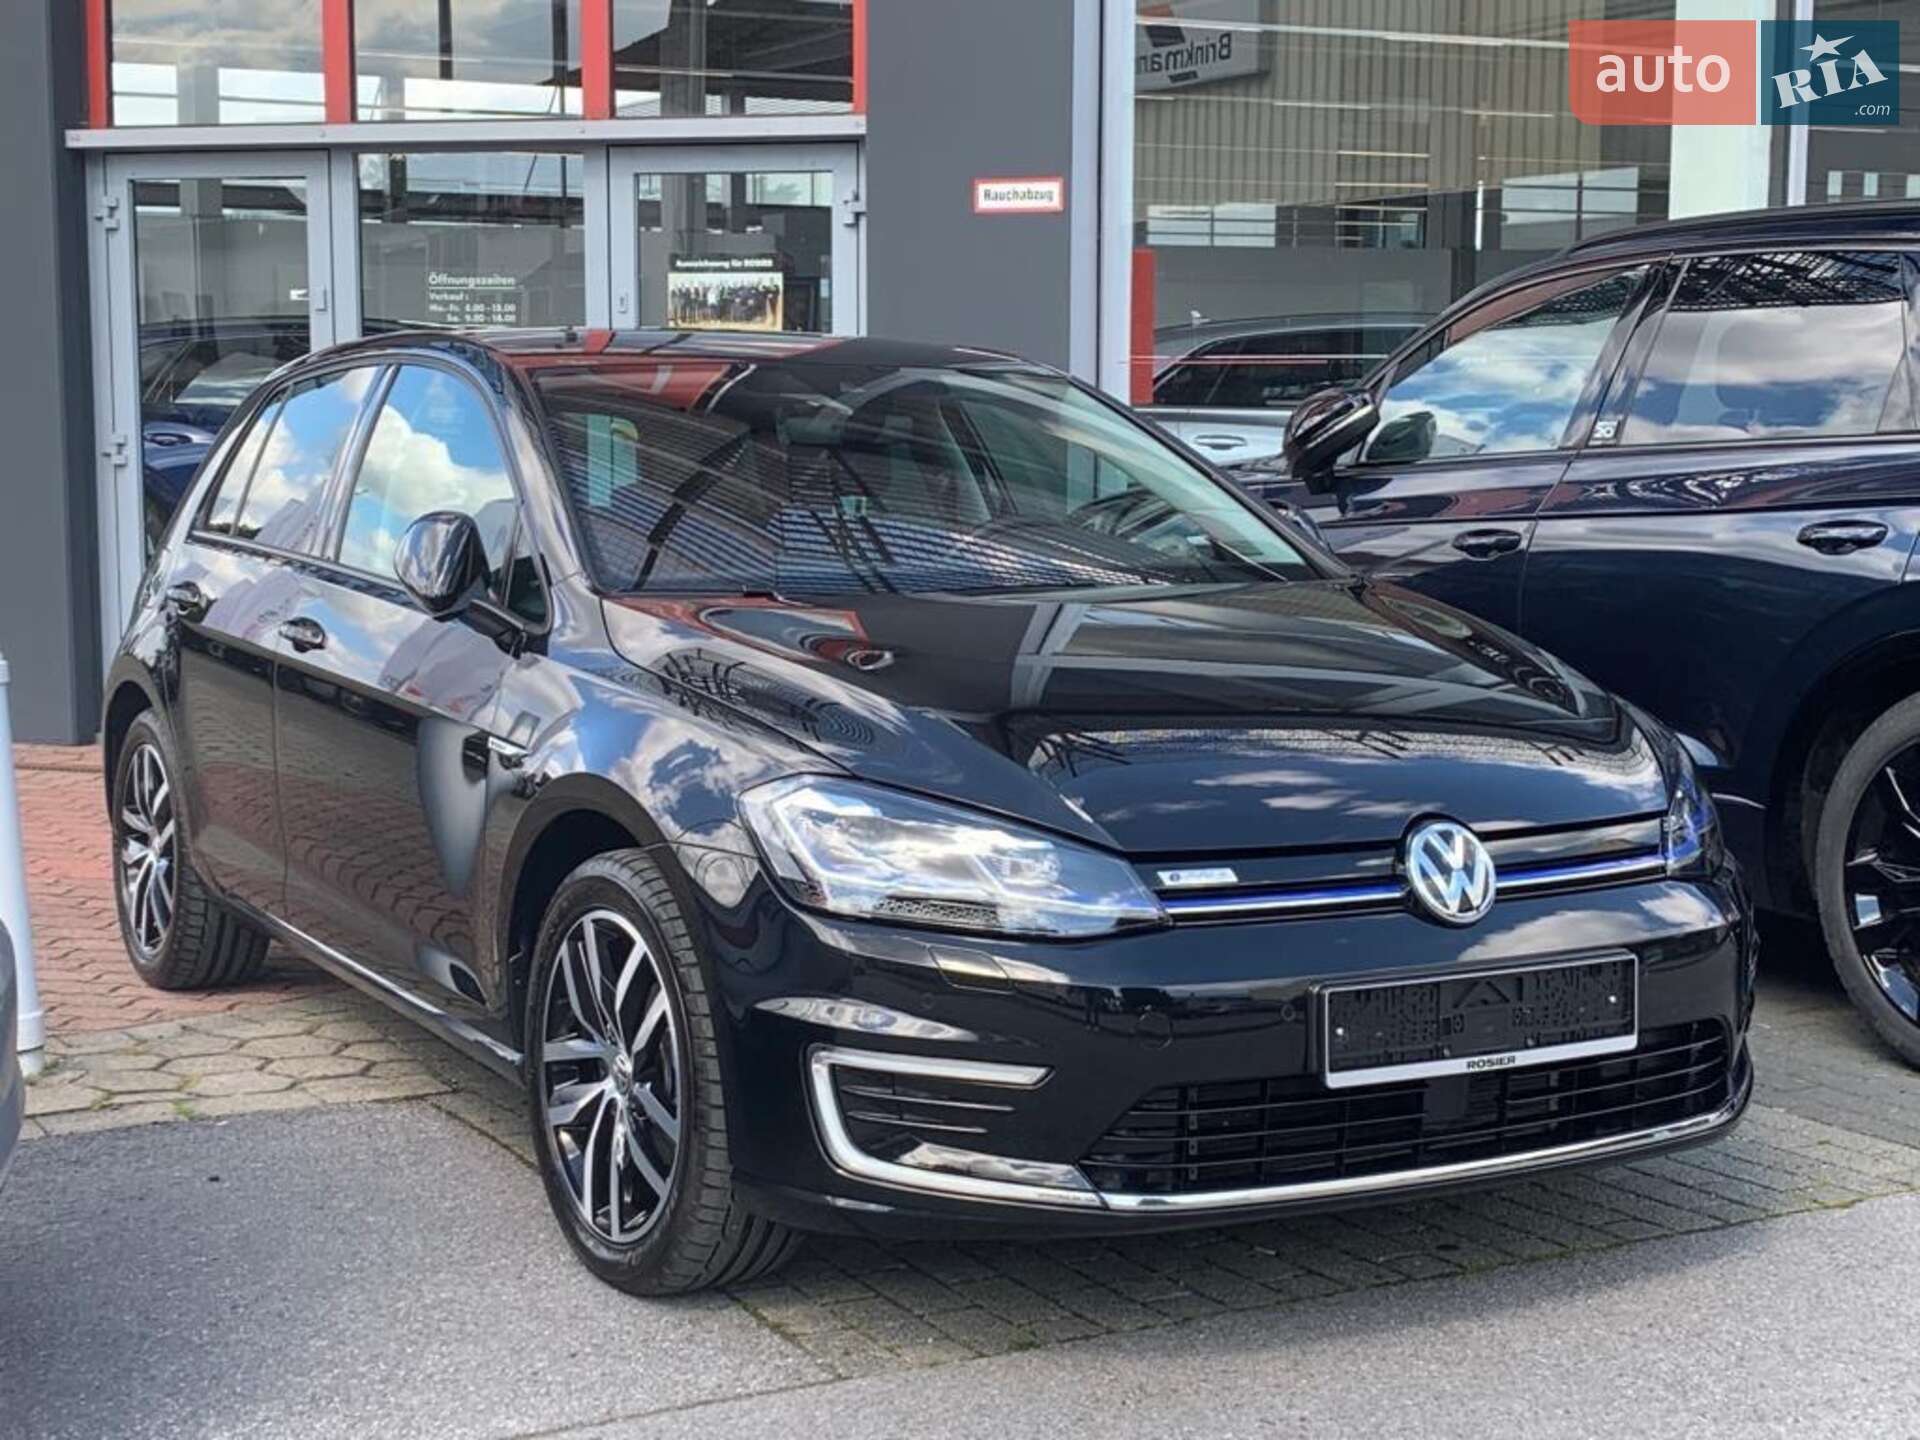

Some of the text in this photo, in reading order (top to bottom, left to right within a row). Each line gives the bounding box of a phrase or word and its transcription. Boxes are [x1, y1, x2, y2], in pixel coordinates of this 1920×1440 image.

[983, 188, 1055, 203] Rauchabzug
[428, 272, 515, 289] Öffnungszeiten
[1467, 1055, 1515, 1069] ROSIER
